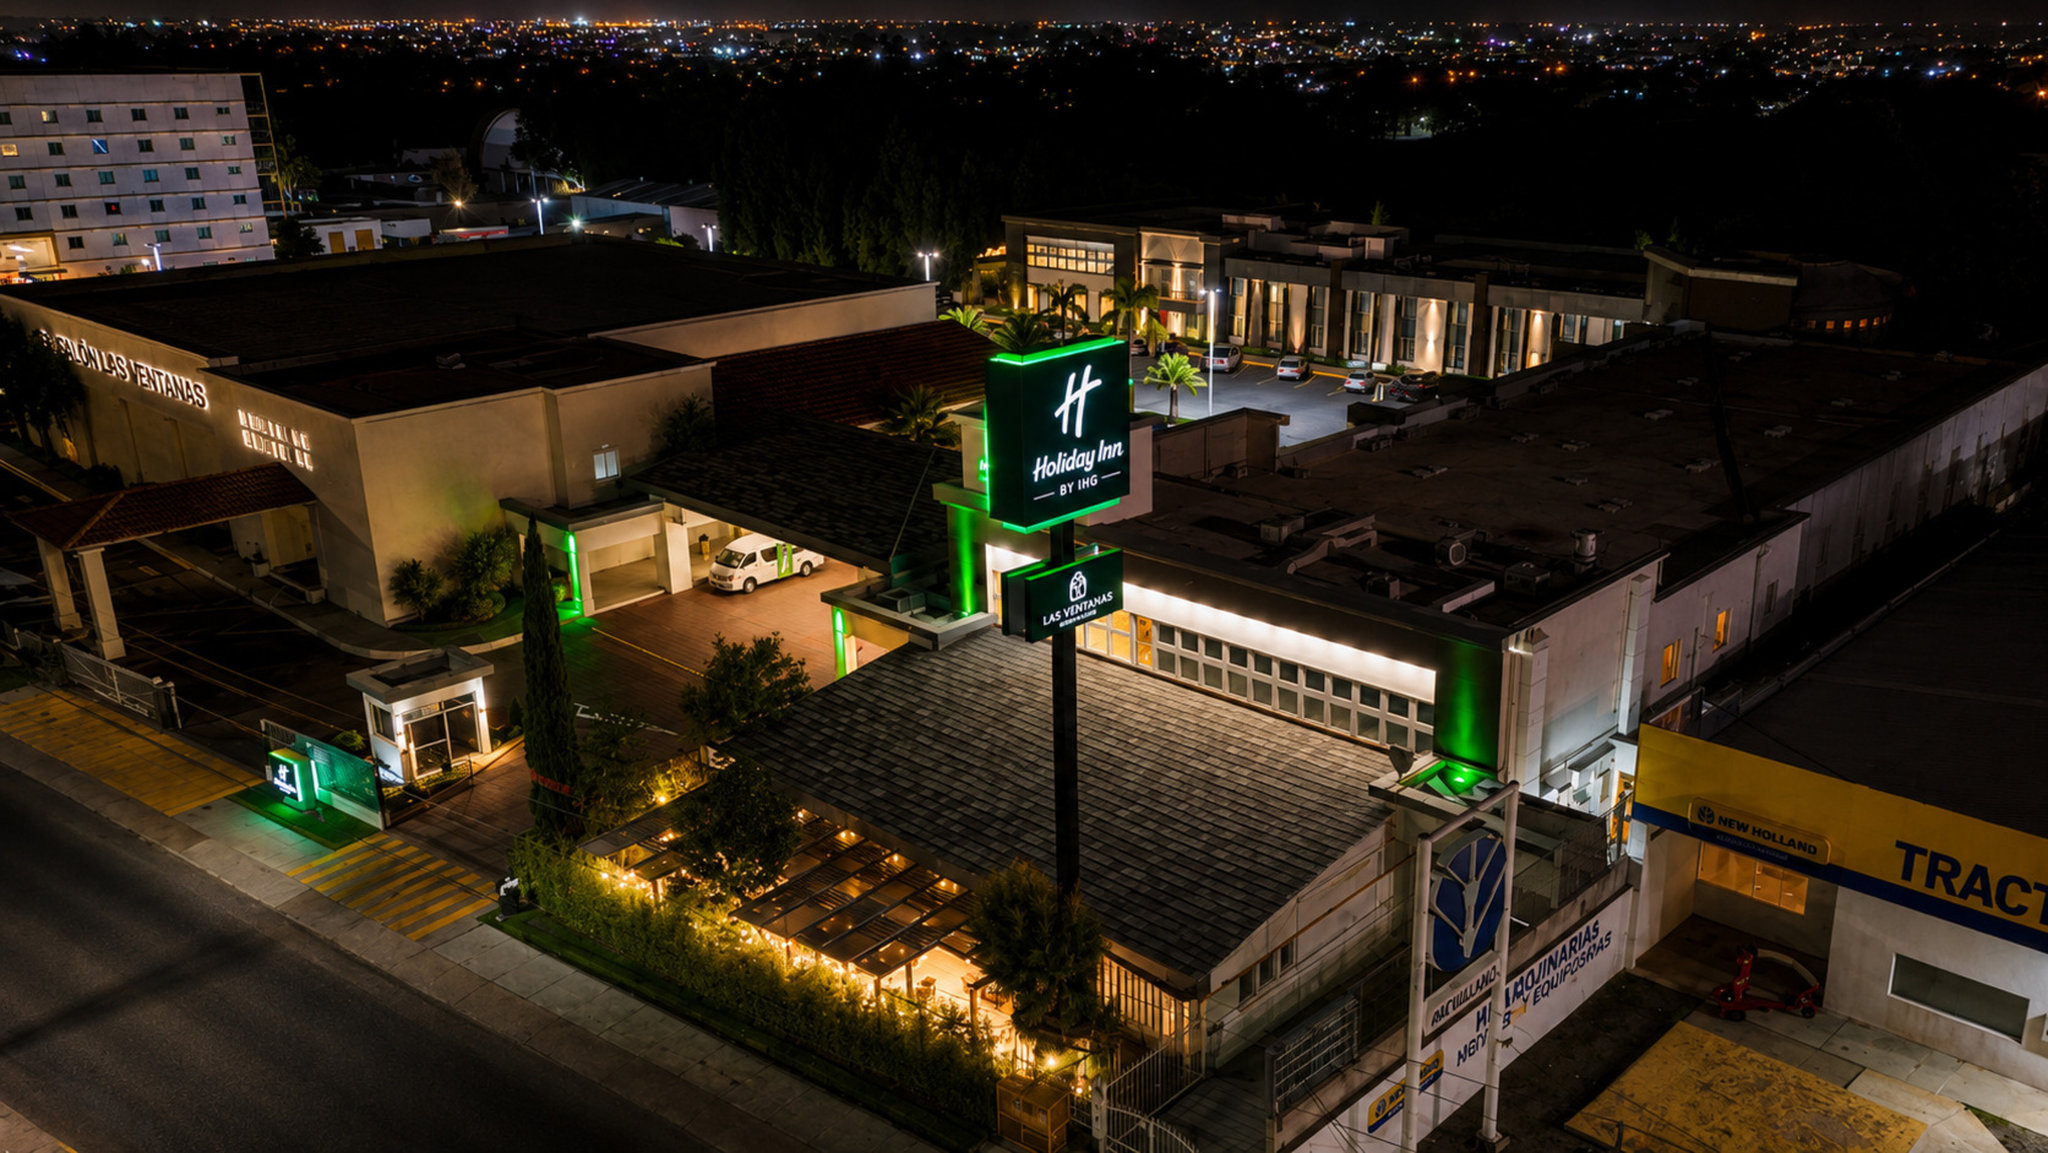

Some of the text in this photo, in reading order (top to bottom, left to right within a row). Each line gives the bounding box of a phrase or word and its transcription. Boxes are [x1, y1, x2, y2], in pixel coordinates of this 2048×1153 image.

[55, 334, 209, 411] SALÓN LAS VENTANAS
[1033, 439, 1124, 482] Holiday Inn
[1059, 474, 1098, 496] BY IHG
[1043, 610, 1061, 626] LAS
[1062, 591, 1113, 618] VENTANAS
[1718, 815, 1749, 832] NEW
[1751, 824, 1817, 855] HOLLAND
